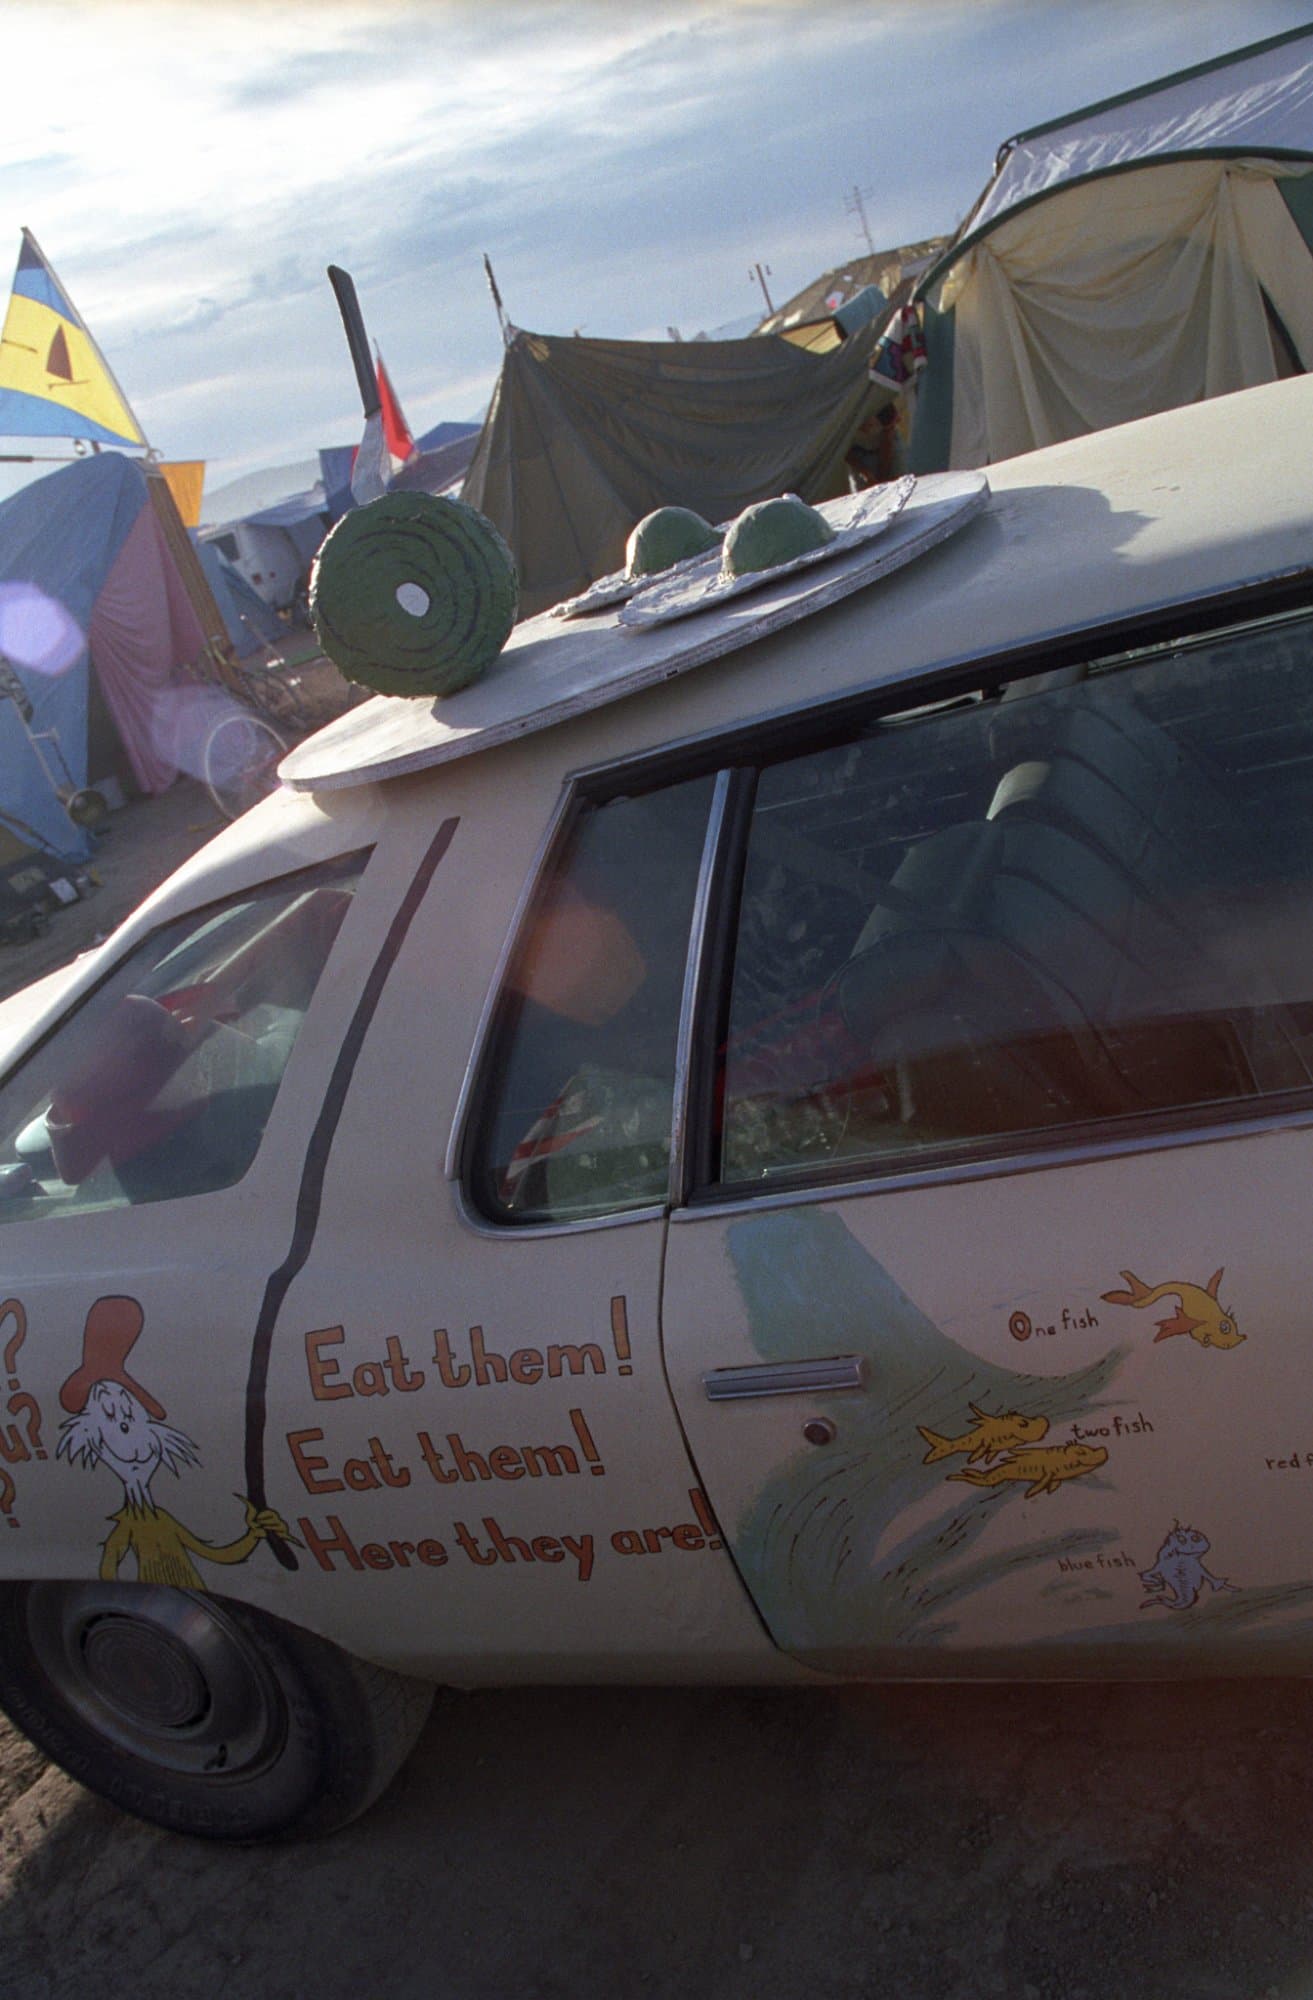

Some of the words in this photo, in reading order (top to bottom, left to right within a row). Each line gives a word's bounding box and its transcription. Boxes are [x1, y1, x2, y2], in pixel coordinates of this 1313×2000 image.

[1009, 1310, 1056, 1341] One
[1062, 1307, 1099, 1330] fish
[305, 1325, 424, 1400] Eat
[433, 1295, 631, 1387] them!
[1071, 1423, 1110, 1440] two
[1113, 1411, 1154, 1436] fish
[286, 1428, 410, 1494] Eat
[417, 1408, 605, 1483] them!
[1264, 1452, 1300, 1470] red
[298, 1515, 449, 1572] Here
[454, 1517, 594, 1581] they
[610, 1488, 723, 1554] are!
[1058, 1557, 1094, 1572] blue
[1097, 1551, 1136, 1568] fish
